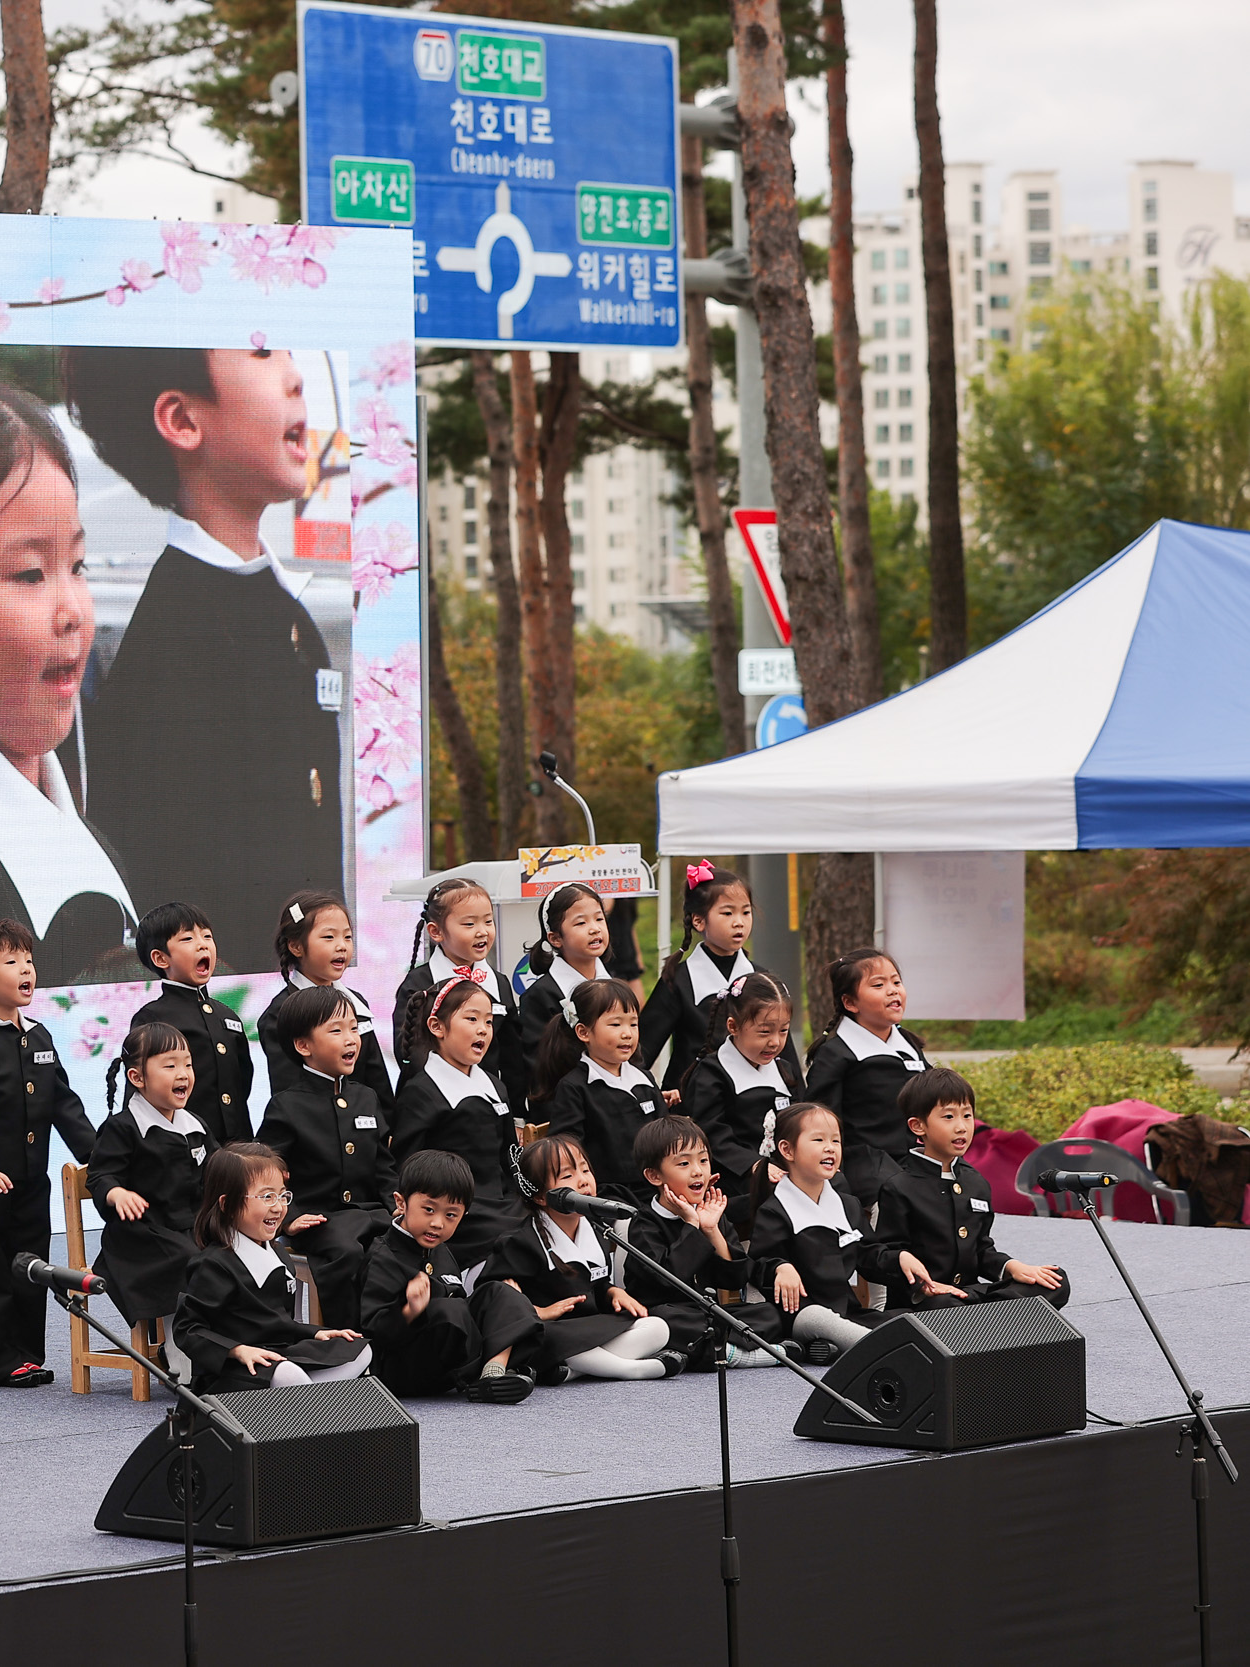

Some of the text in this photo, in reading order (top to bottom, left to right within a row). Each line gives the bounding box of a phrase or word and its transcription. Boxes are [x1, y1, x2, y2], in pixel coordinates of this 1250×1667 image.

[424, 42, 446, 71] 70
[460, 42, 543, 83] 천호대교
[450, 98, 554, 145] 천호대로
[451, 147, 555, 180] Cheonho-daero
[336, 170, 409, 214] 아차산
[576, 251, 676, 300] 워커힐로
[578, 298, 676, 327] Walkerhill-ro
[593, 880, 619, 891] 해오름
[622, 879, 639, 890] 축제
